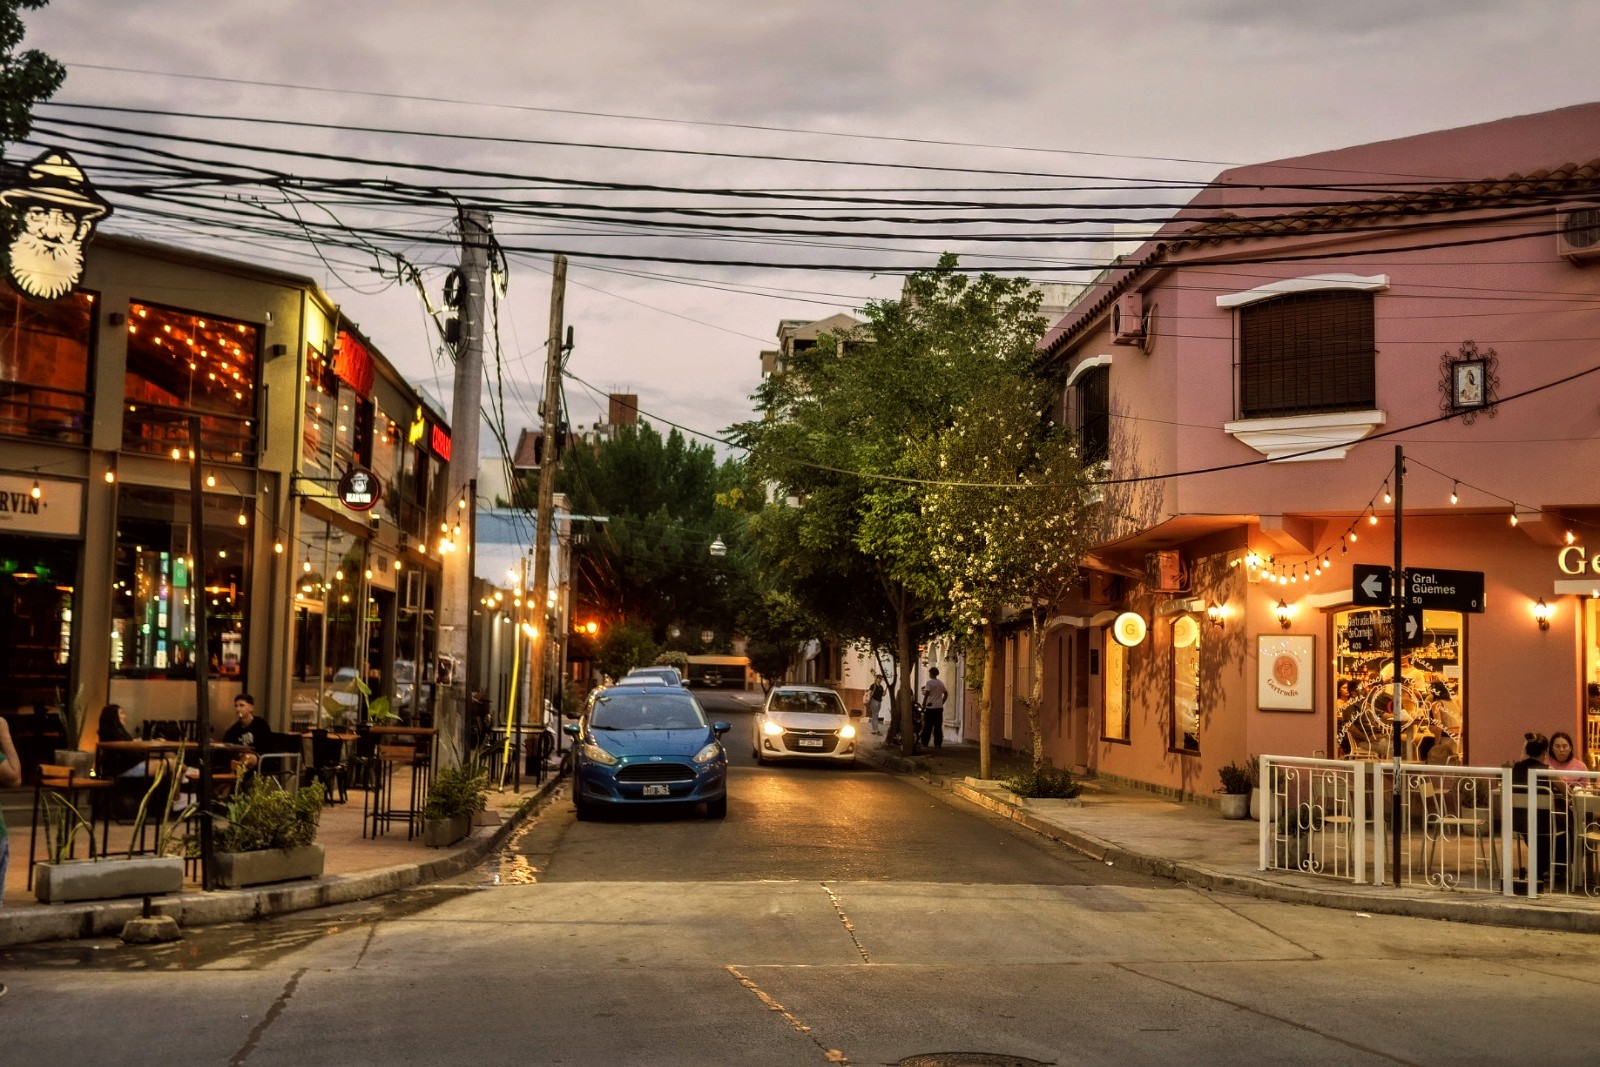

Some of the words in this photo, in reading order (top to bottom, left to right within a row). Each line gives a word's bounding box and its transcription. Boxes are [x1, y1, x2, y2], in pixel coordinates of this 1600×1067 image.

[1412, 573, 1438, 584] Gral.
[1412, 583, 1456, 595] Güemes
[1412, 596, 1422, 604] 50
[1471, 600, 1477, 608] 0
[1348, 614, 1369, 627] Gertrudis
[1125, 623, 1135, 635] G
[1348, 627, 1354, 639] de
[1354, 626, 1373, 641] Cornejo
[1267, 678, 1299, 696] Gertrudis
